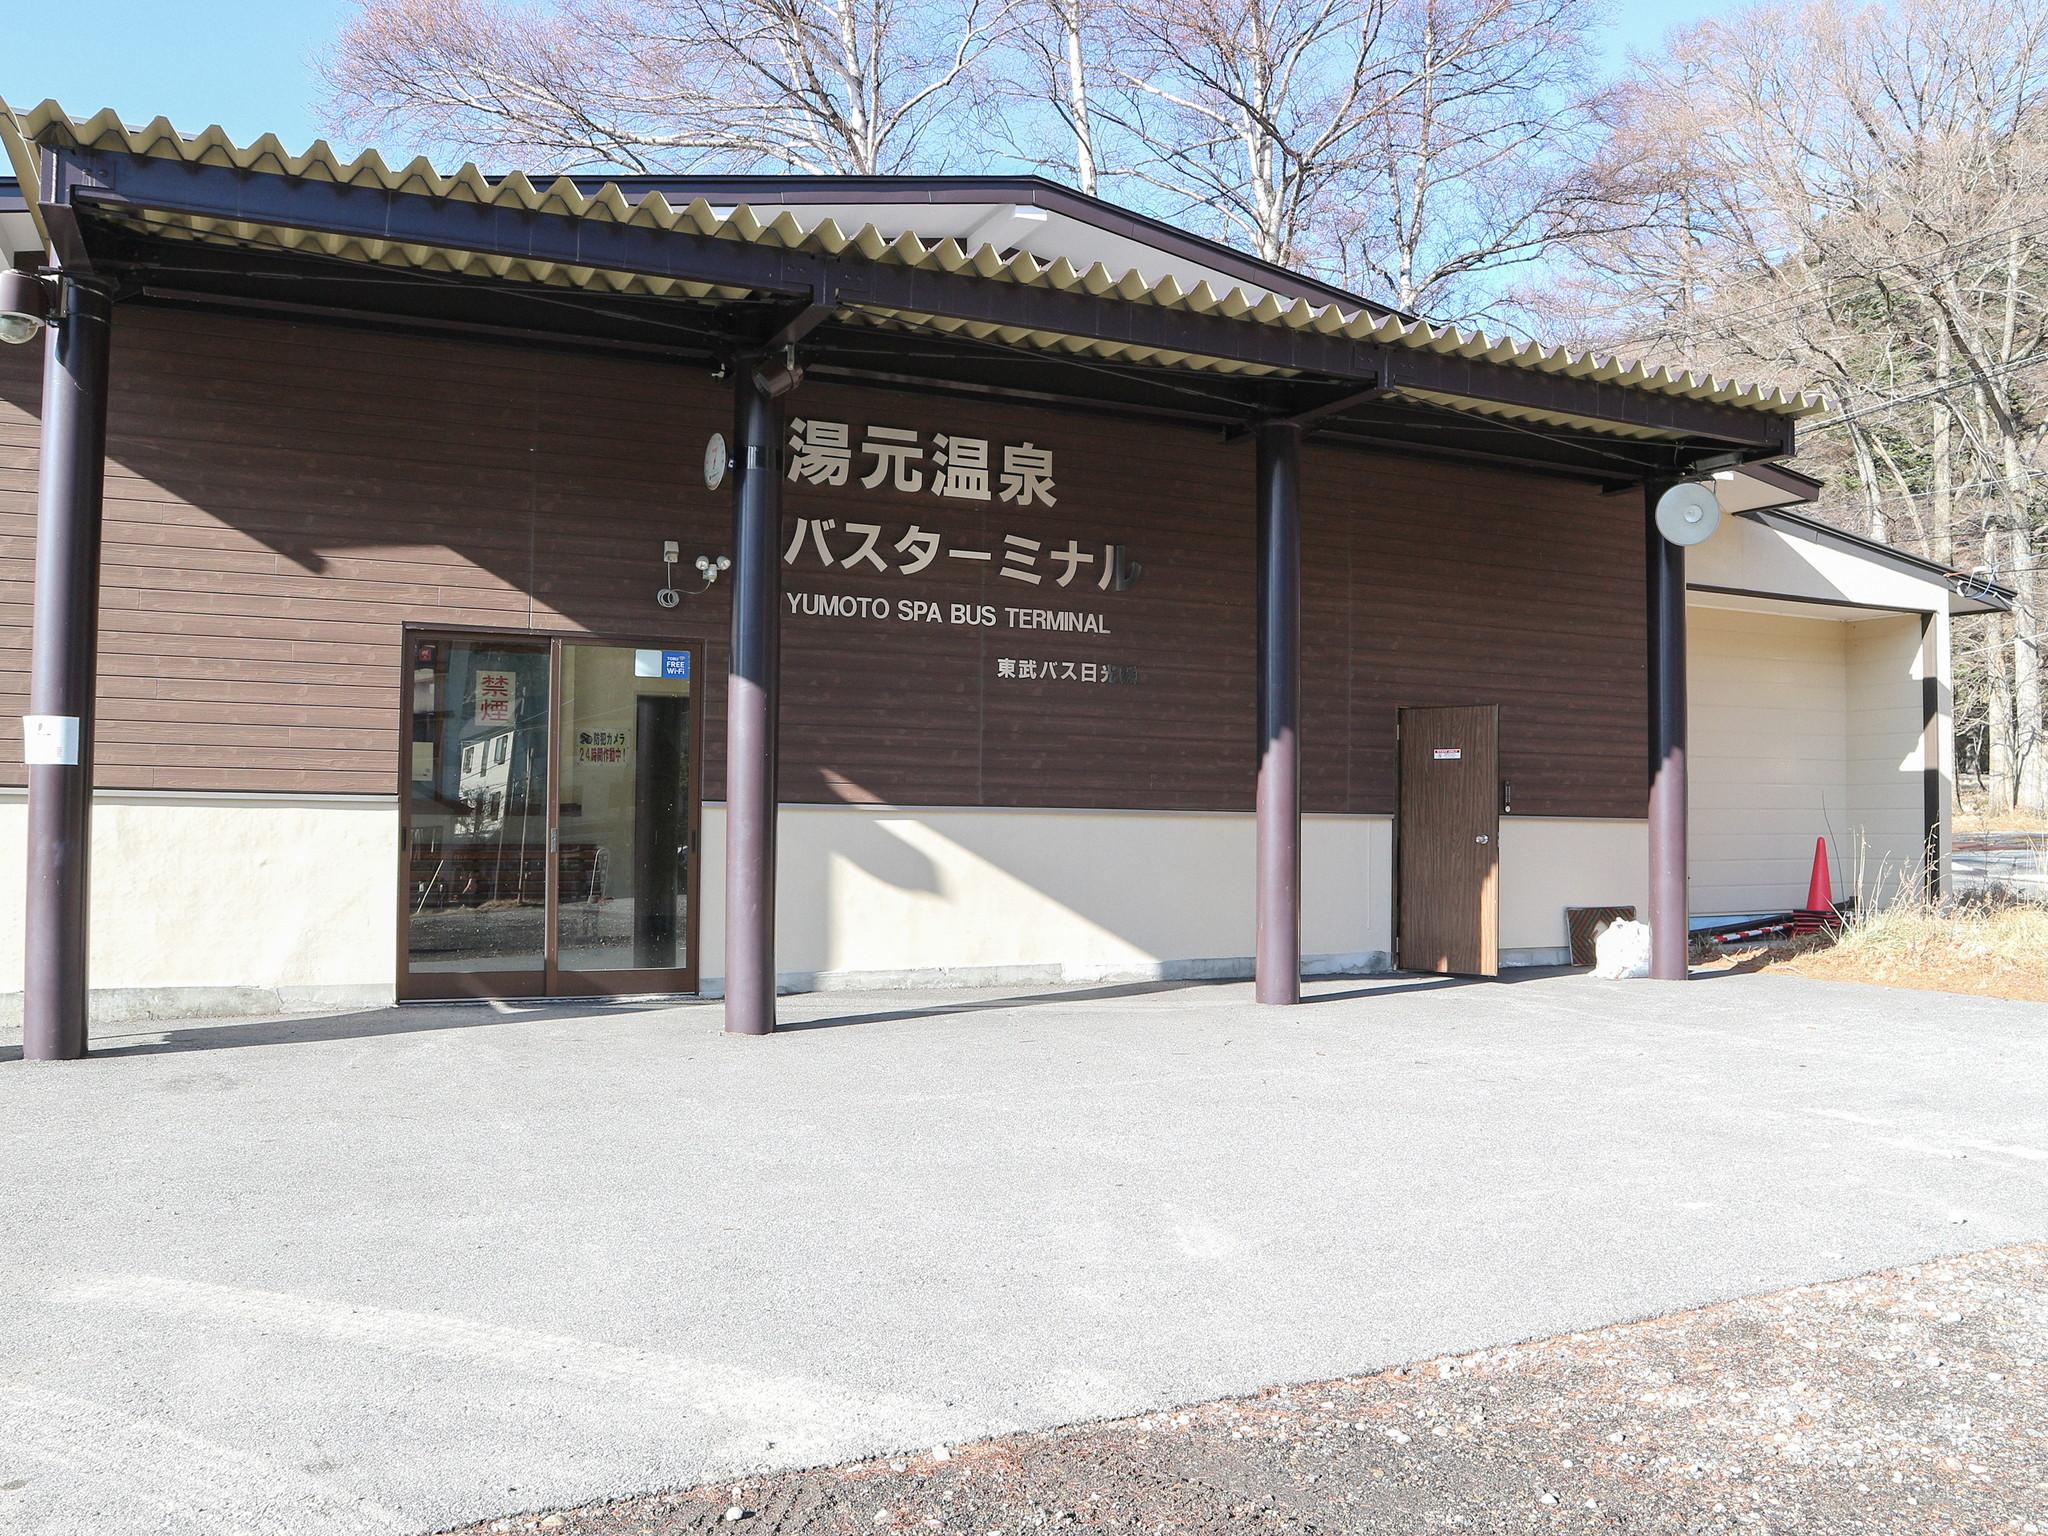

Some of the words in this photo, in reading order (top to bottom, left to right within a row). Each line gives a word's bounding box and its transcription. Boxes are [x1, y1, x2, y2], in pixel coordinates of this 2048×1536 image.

[787, 417, 1058, 508] 湯元温泉
[783, 517, 1143, 592] バスターミナル
[786, 592, 890, 620] YUMOTO
[897, 599, 943, 624] SPA
[950, 602, 997, 627] BUS
[1004, 607, 1112, 635] TERMINAL
[666, 660, 686, 669] FREE
[666, 667, 686, 675] Wi-Fi
[480, 674, 510, 722] 禁煙
[593, 731, 626, 746] 防犯カメラ
